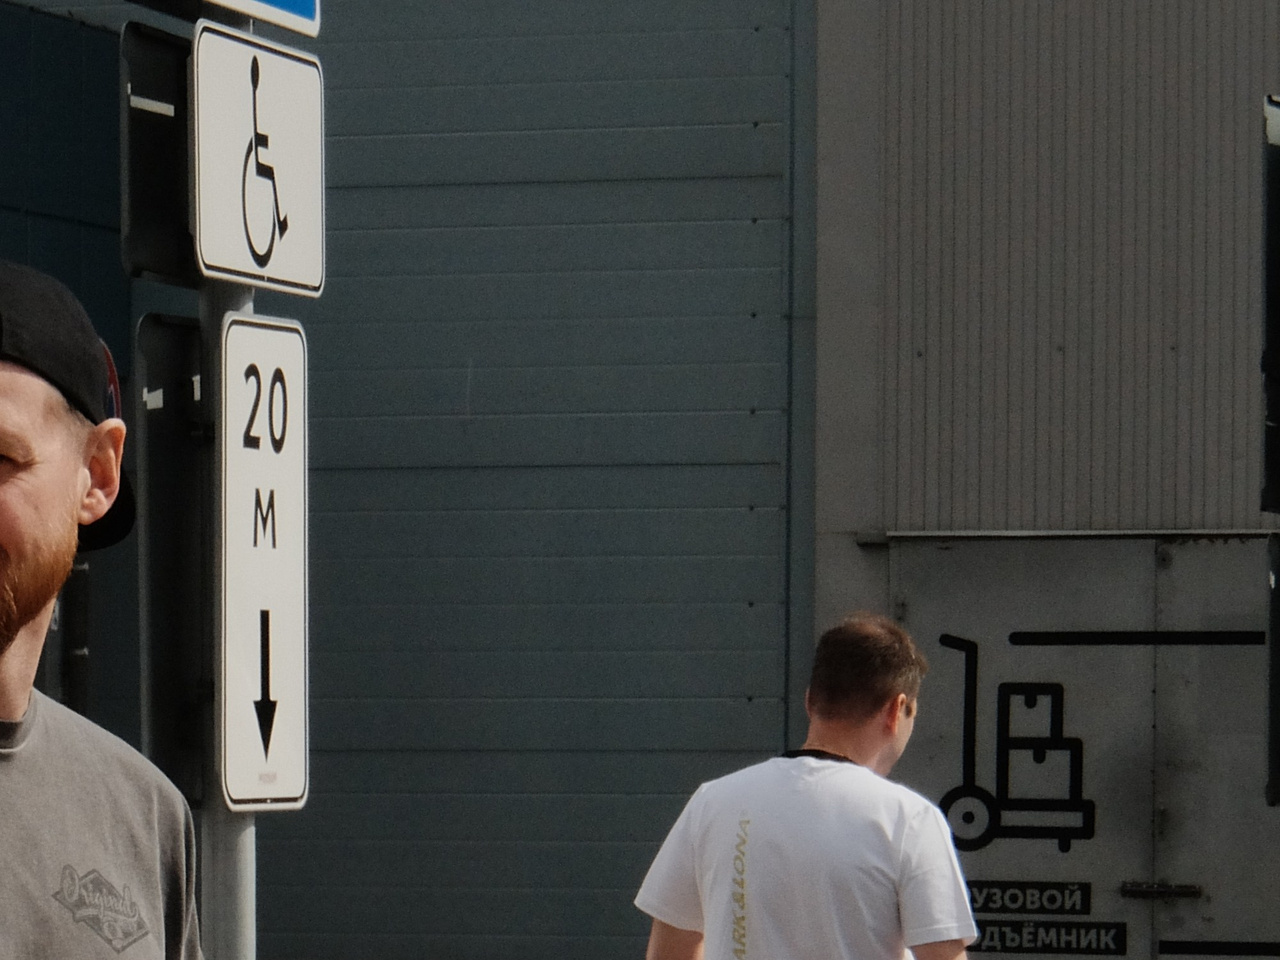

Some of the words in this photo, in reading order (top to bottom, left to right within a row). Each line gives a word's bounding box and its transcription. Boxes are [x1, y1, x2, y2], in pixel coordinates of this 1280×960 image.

[243, 363, 288, 454] 20
[972, 884, 1083, 911] УЗОВОЙ
[977, 921, 1117, 951] ДЪЁМНИК
